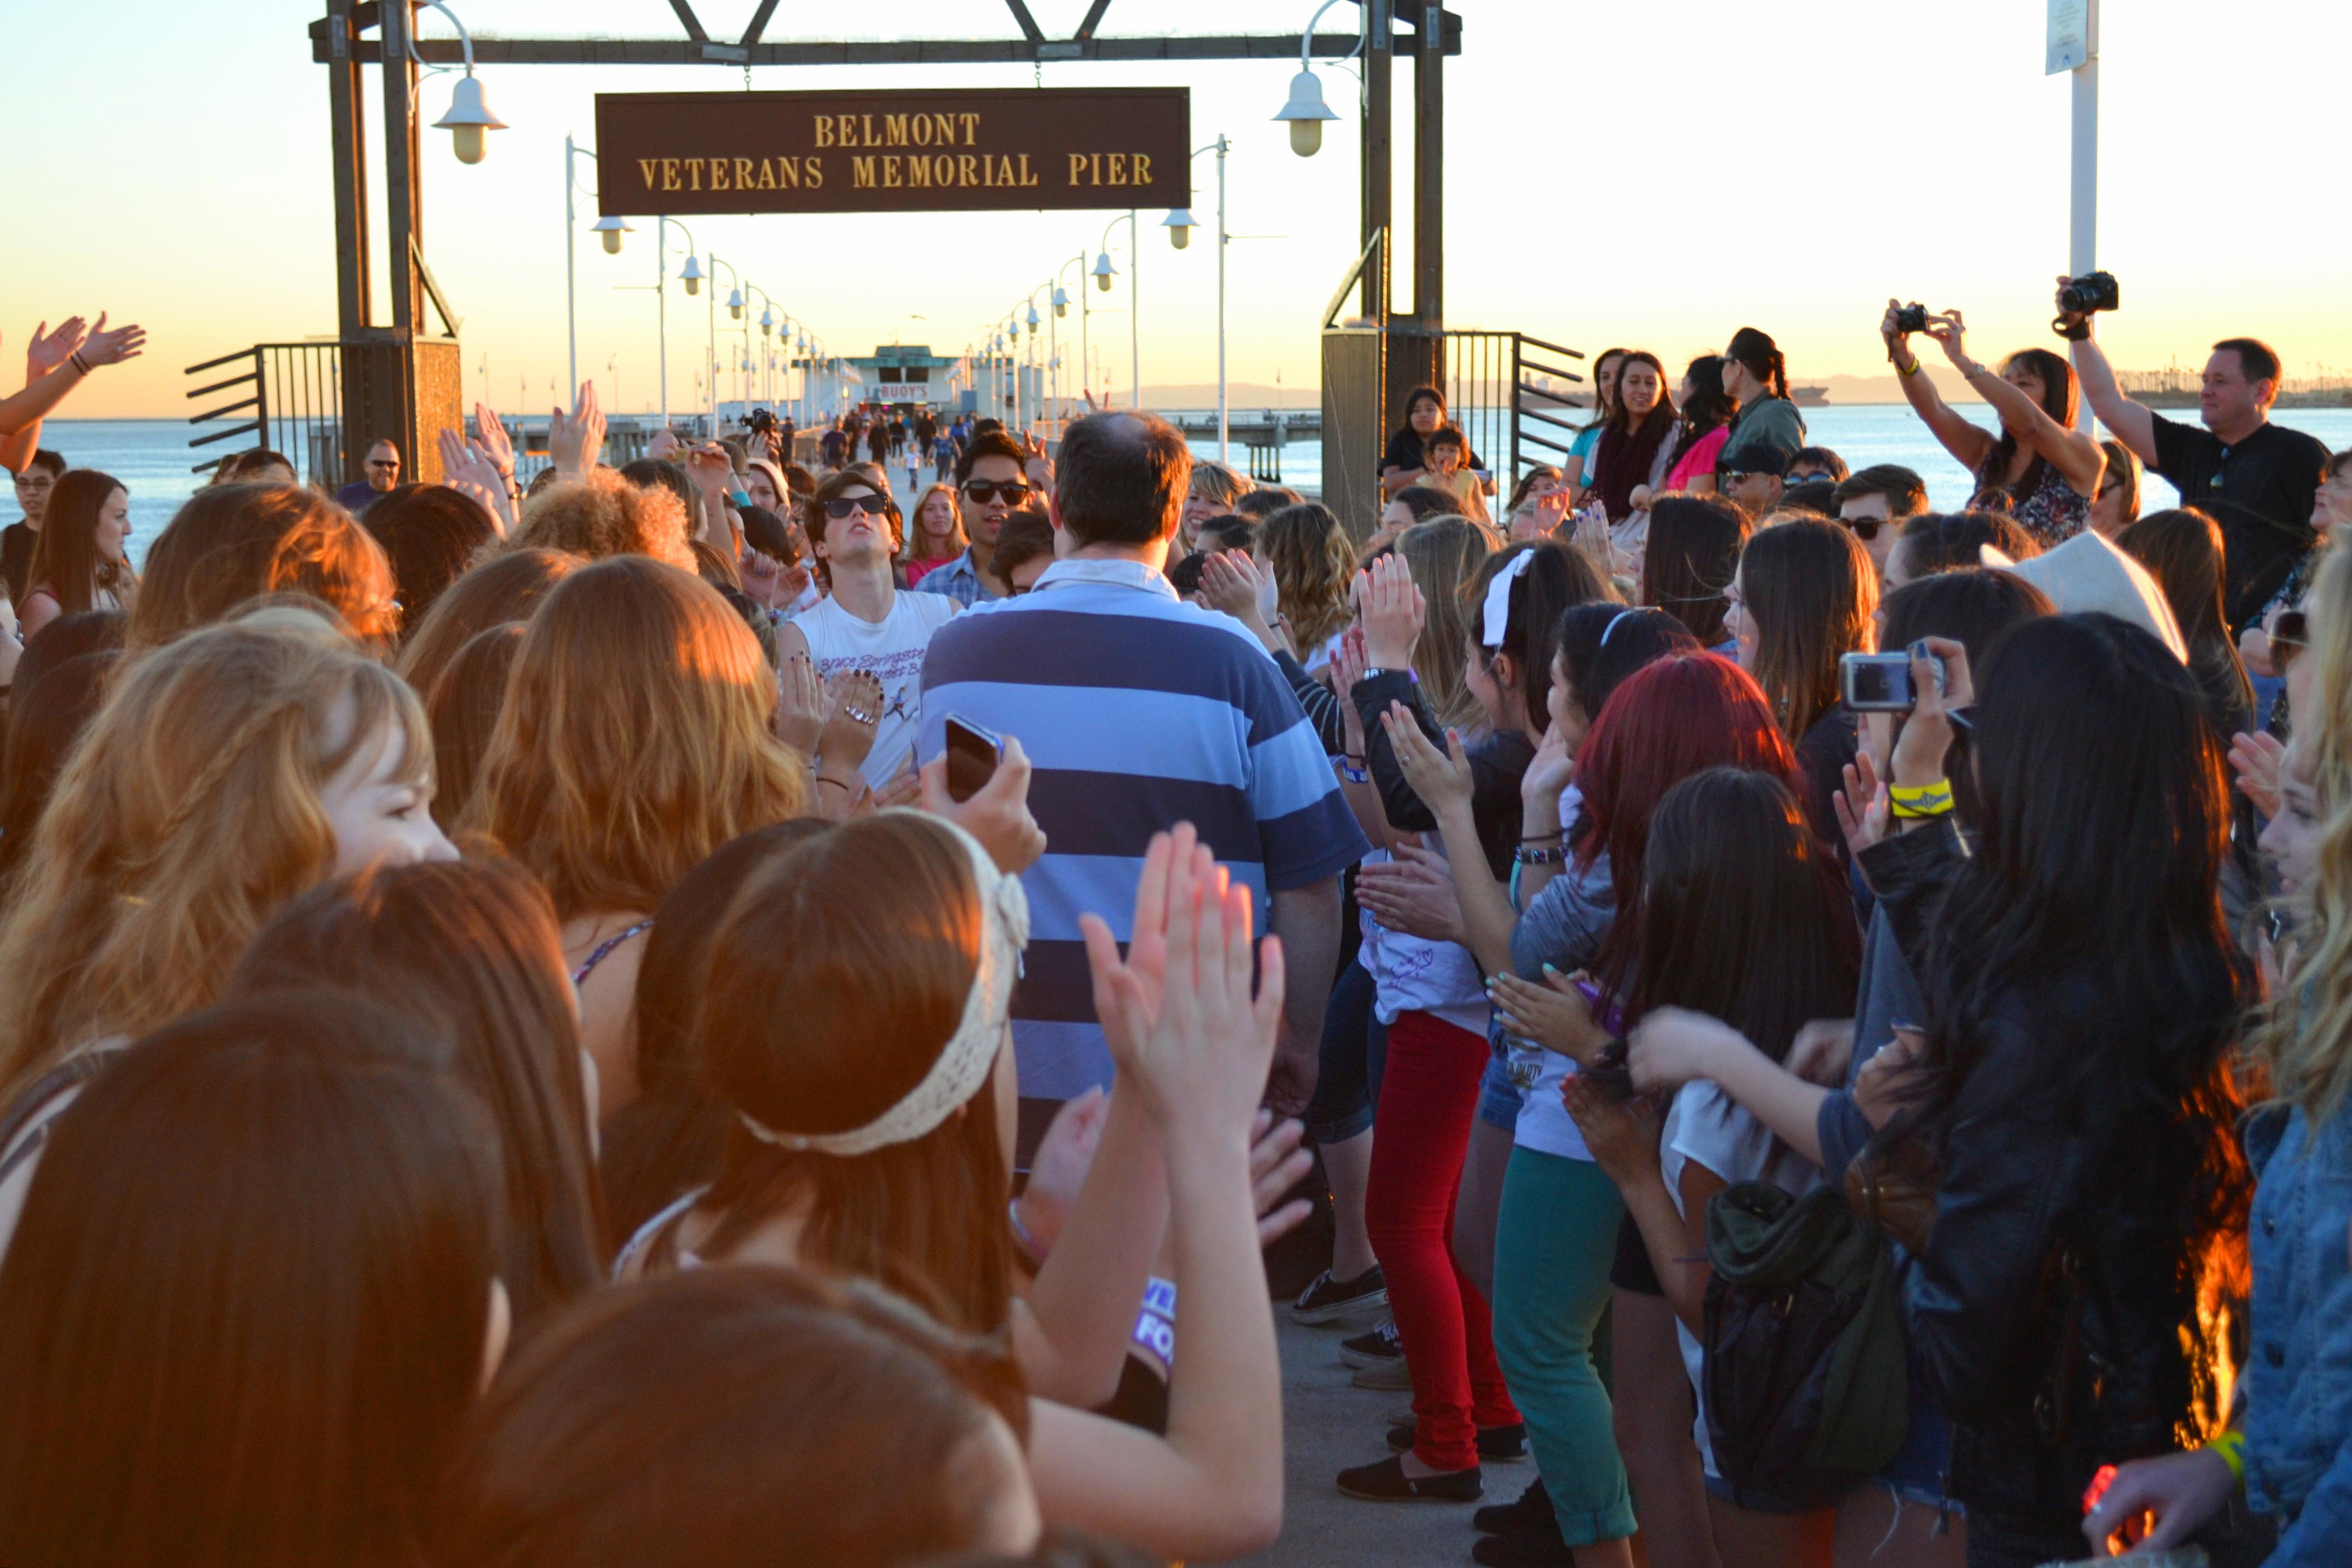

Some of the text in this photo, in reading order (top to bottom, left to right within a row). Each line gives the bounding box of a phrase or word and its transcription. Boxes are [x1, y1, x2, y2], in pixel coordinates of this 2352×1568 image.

[814, 113, 980, 147] BELMONT
[637, 153, 1153, 191] VETERANS MEMORIAL PIER
[881, 385, 928, 398] BUOY'S
[857, 648, 925, 668] Springste
